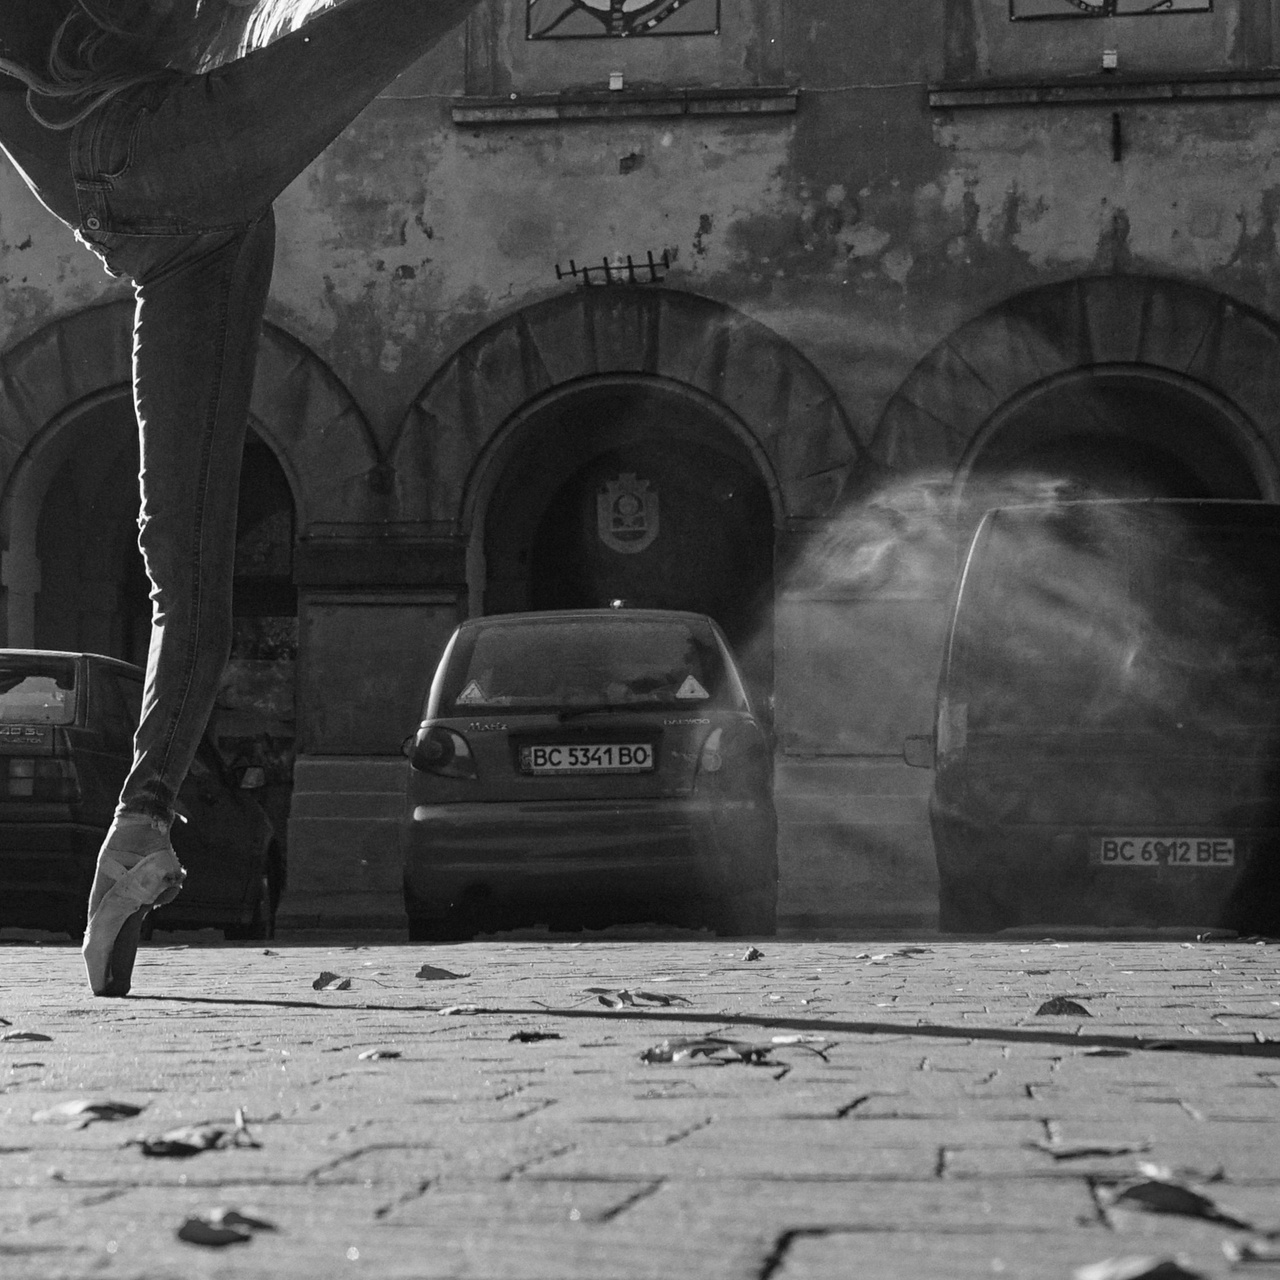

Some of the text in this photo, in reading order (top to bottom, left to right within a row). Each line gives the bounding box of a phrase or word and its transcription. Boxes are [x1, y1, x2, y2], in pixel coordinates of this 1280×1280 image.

[533, 746, 648, 767] BC 5341 BO
[1103, 840, 1135, 862] BC
[1196, 841, 1229, 863] BE
